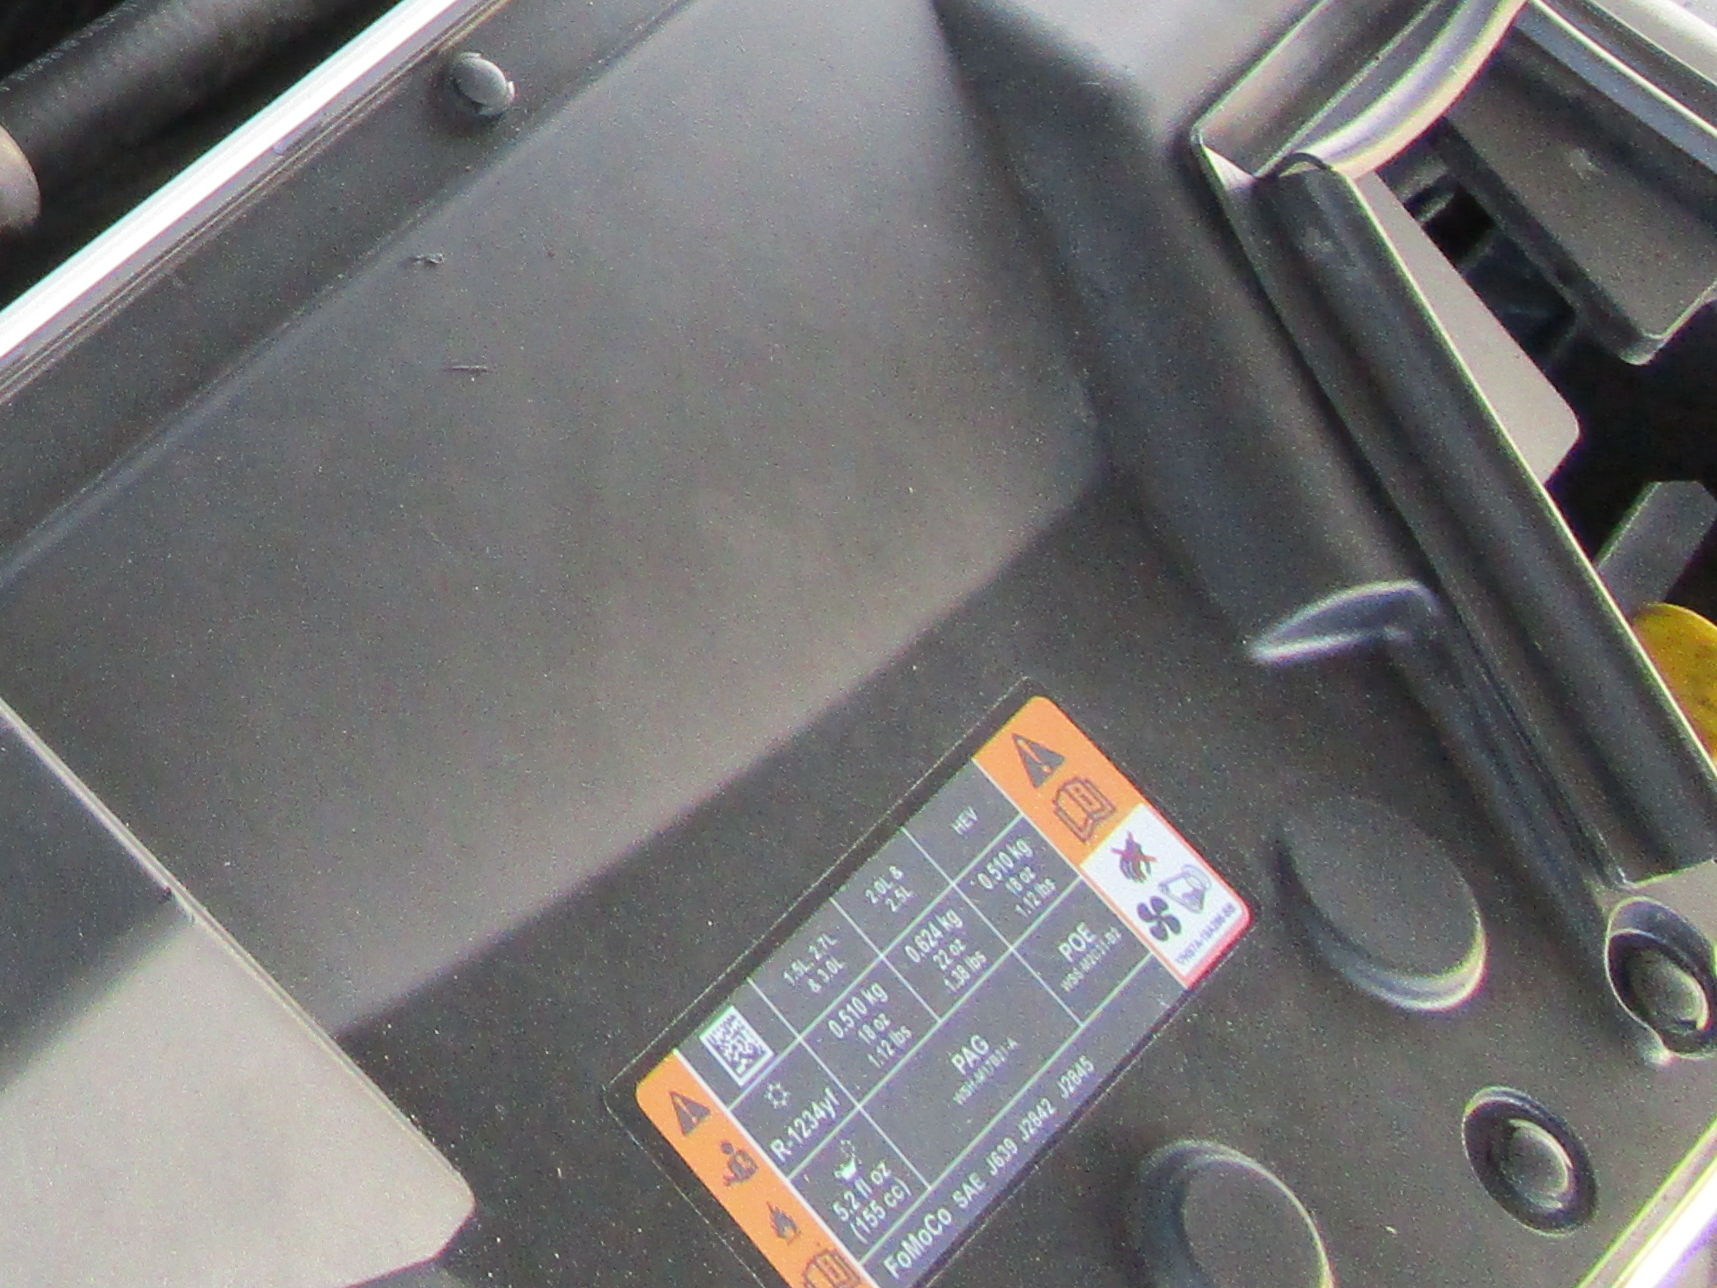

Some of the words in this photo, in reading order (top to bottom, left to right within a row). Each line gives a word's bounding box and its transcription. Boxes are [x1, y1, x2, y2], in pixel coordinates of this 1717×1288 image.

[952, 807, 977, 834] HEV
[977, 852, 1014, 889] 0.510
[1006, 839, 1033, 860] kg
[1005, 877, 1023, 894] 18
[1019, 866, 1036, 884] oz
[865, 877, 894, 904] 2.0L
[889, 865, 903, 880] &
[885, 886, 913, 912] 2.5L
[1015, 891, 1041, 917] 1.12
[1034, 878, 1056, 898] lbs
[808, 934, 837, 961] 2.7L
[905, 922, 943, 963] 0.624
[936, 909, 963, 931] kg
[932, 949, 953, 971] 22
[949, 938, 966, 956] oz
[1058, 923, 1096, 962] POE
[807, 978, 822, 993] &
[817, 957, 845, 983] 3.0L
[944, 964, 971, 991] 1.38
[964, 951, 987, 972] lbs
[828, 997, 867, 1038] 0.510
[861, 983, 888, 1005] kg
[858, 1024, 877, 1044] 18
[873, 1013, 891, 1031] oz
[867, 1039, 895, 1068] 1.12
[888, 1026, 912, 1047] lbs
[951, 1035, 989, 1074] PAG
[770, 1088, 839, 1161] R-1234yf
[884, 1209, 952, 1278] FoMoCo
[952, 1173, 985, 1208] SAE
[987, 1138, 1018, 1176] J639
[1019, 1098, 1055, 1141] J2842
[1058, 1056, 1094, 1098] J2845
[833, 1190, 861, 1221] 5.2
[854, 1177, 873, 1199] fl
[870, 1162, 891, 1185] oz
[850, 1200, 886, 1243] (155
[884, 1177, 911, 1208] cc)
